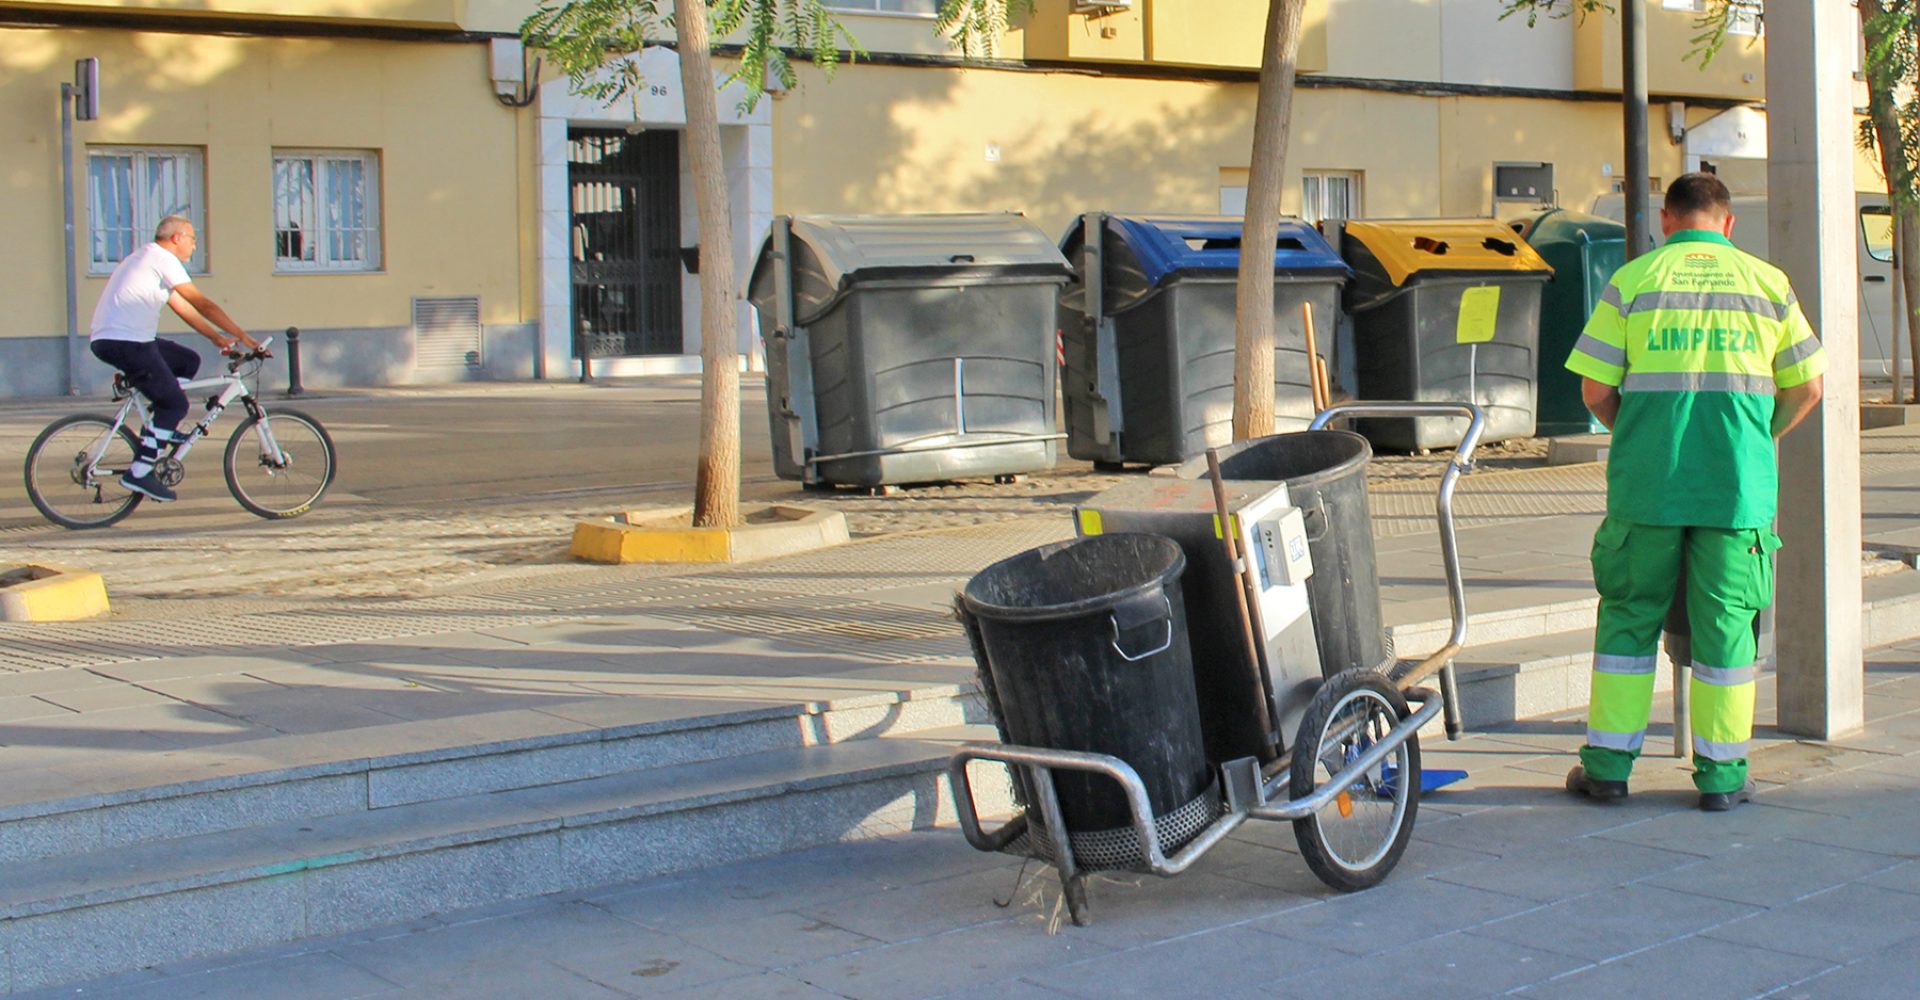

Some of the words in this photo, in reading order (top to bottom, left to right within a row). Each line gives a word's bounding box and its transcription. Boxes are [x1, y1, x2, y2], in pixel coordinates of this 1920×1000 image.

[651, 85, 668, 97] 96
[1672, 270, 1724, 278] Ayuntamiento
[1671, 278, 1689, 286] San
[1692, 278, 1736, 287] Fernando
[1647, 327, 1757, 353] LIMPIEZA
